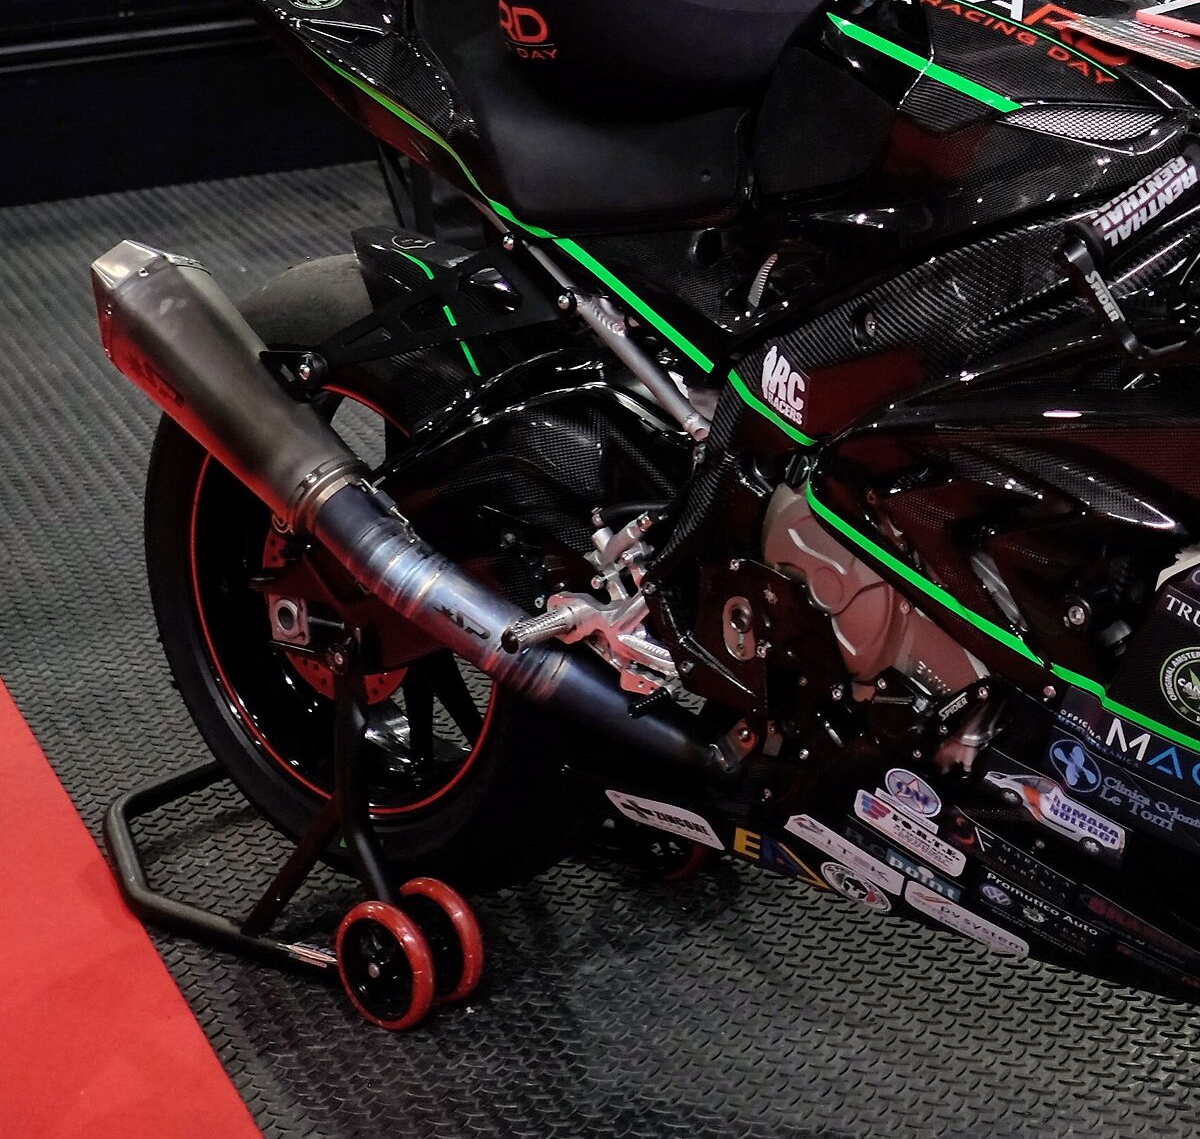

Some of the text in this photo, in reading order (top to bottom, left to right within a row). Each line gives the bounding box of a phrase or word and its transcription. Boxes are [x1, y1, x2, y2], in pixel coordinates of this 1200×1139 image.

[1047, 45, 1115, 85] DAY
[1104, 165, 1199, 247] RENTHAL
[1164, 669, 1178, 702] ORIGINAL
[1100, 784, 1175, 832] Le Torri
[1062, 914, 1099, 937] Auto
